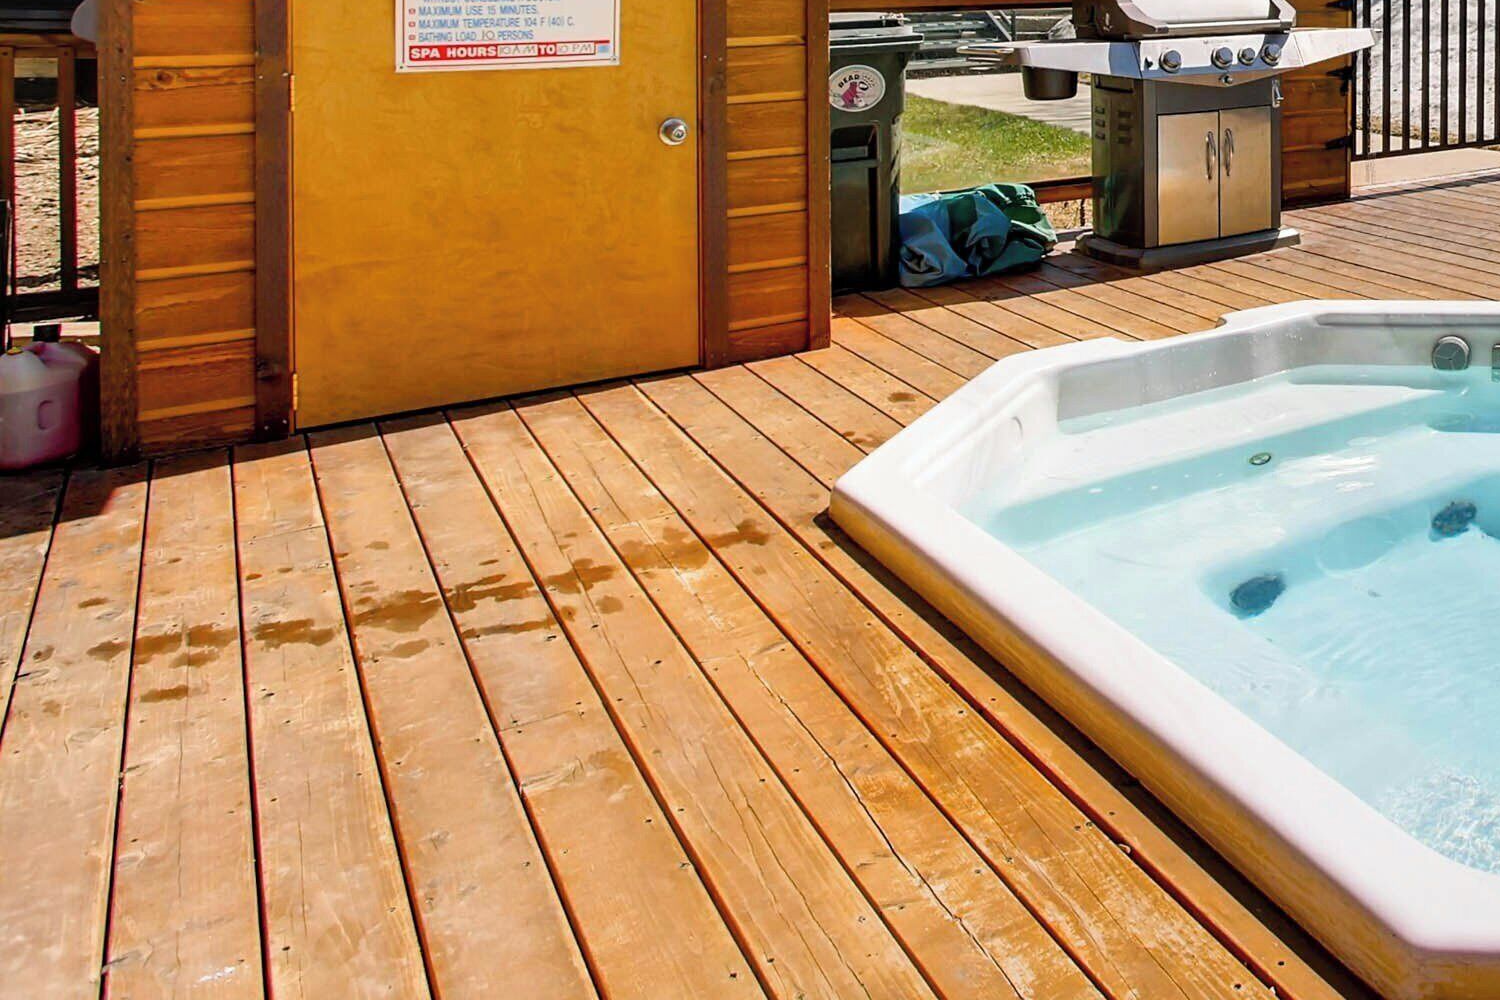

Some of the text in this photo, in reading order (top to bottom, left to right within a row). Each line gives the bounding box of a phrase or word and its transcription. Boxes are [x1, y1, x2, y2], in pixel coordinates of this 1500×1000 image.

[418, 6, 462, 16] MAXIMUM
[466, 6, 484, 16] USE
[488, 6, 496, 15] 15
[418, 19, 459, 28] MAXIMUM
[463, 18, 520, 28] TEMPERATURE
[524, 18, 538, 28] 104
[418, 31, 453, 42] BATHING
[456, 31, 476, 41] LOAD
[498, 30, 534, 40] PERSONS
[411, 48, 440, 59] SPA
[446, 46, 497, 58] HOURS
[540, 45, 555, 55] TO
